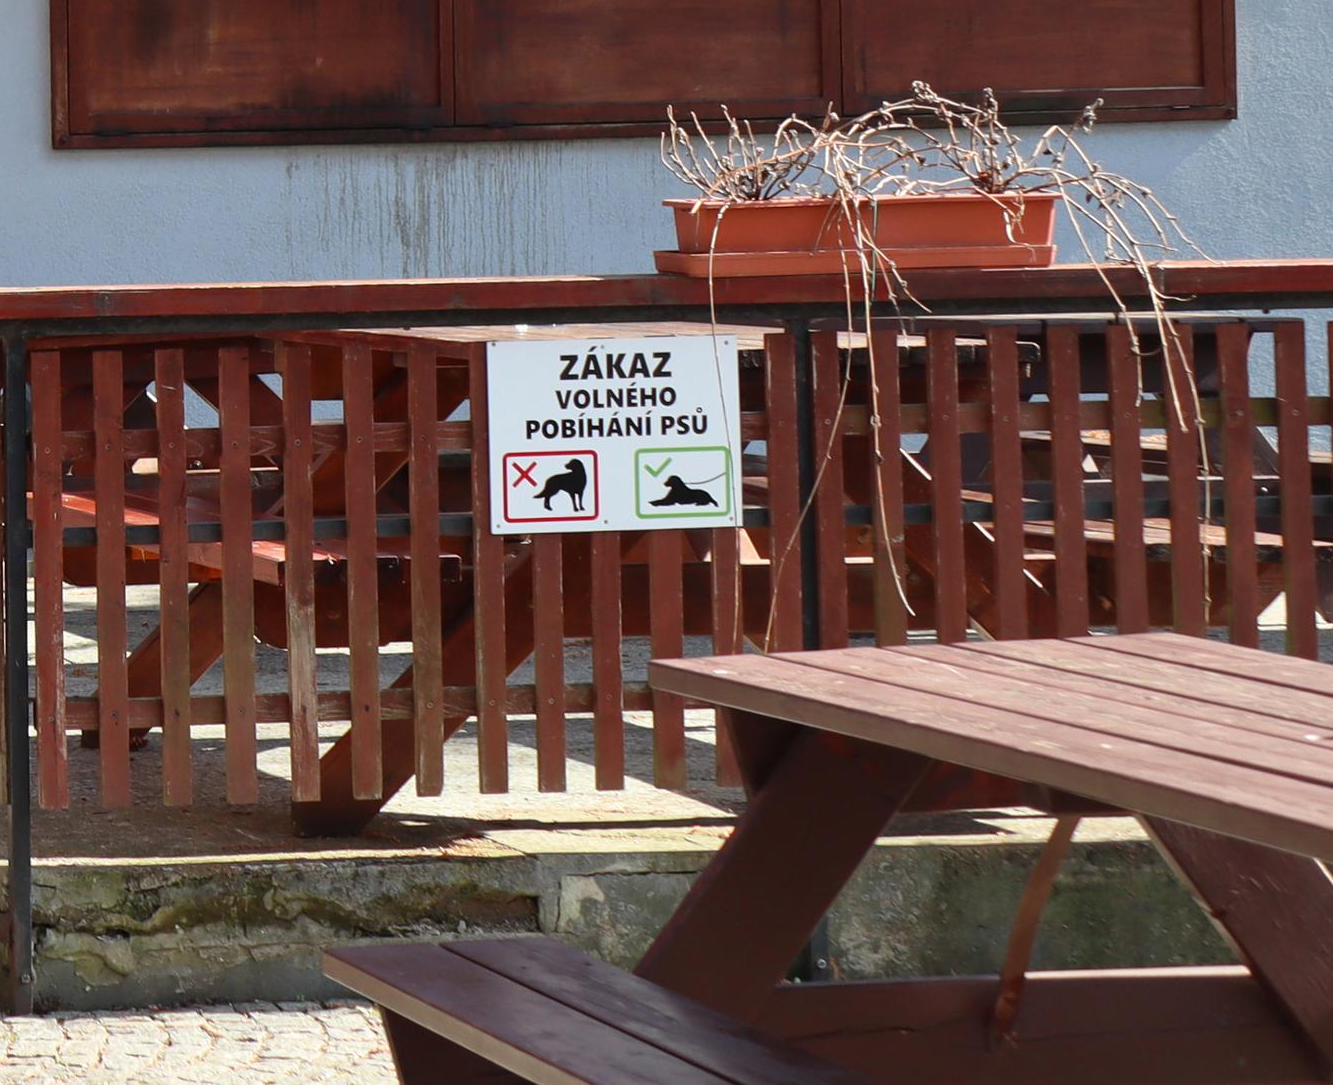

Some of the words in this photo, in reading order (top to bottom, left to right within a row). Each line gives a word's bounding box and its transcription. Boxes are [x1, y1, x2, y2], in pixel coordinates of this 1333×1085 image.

[559, 346, 673, 381] ZÁKAZ
[555, 382, 677, 410] VOLNÉHO
[525, 411, 652, 440] POBÍHÁNÍ
[660, 407, 708, 436] PSŮ
